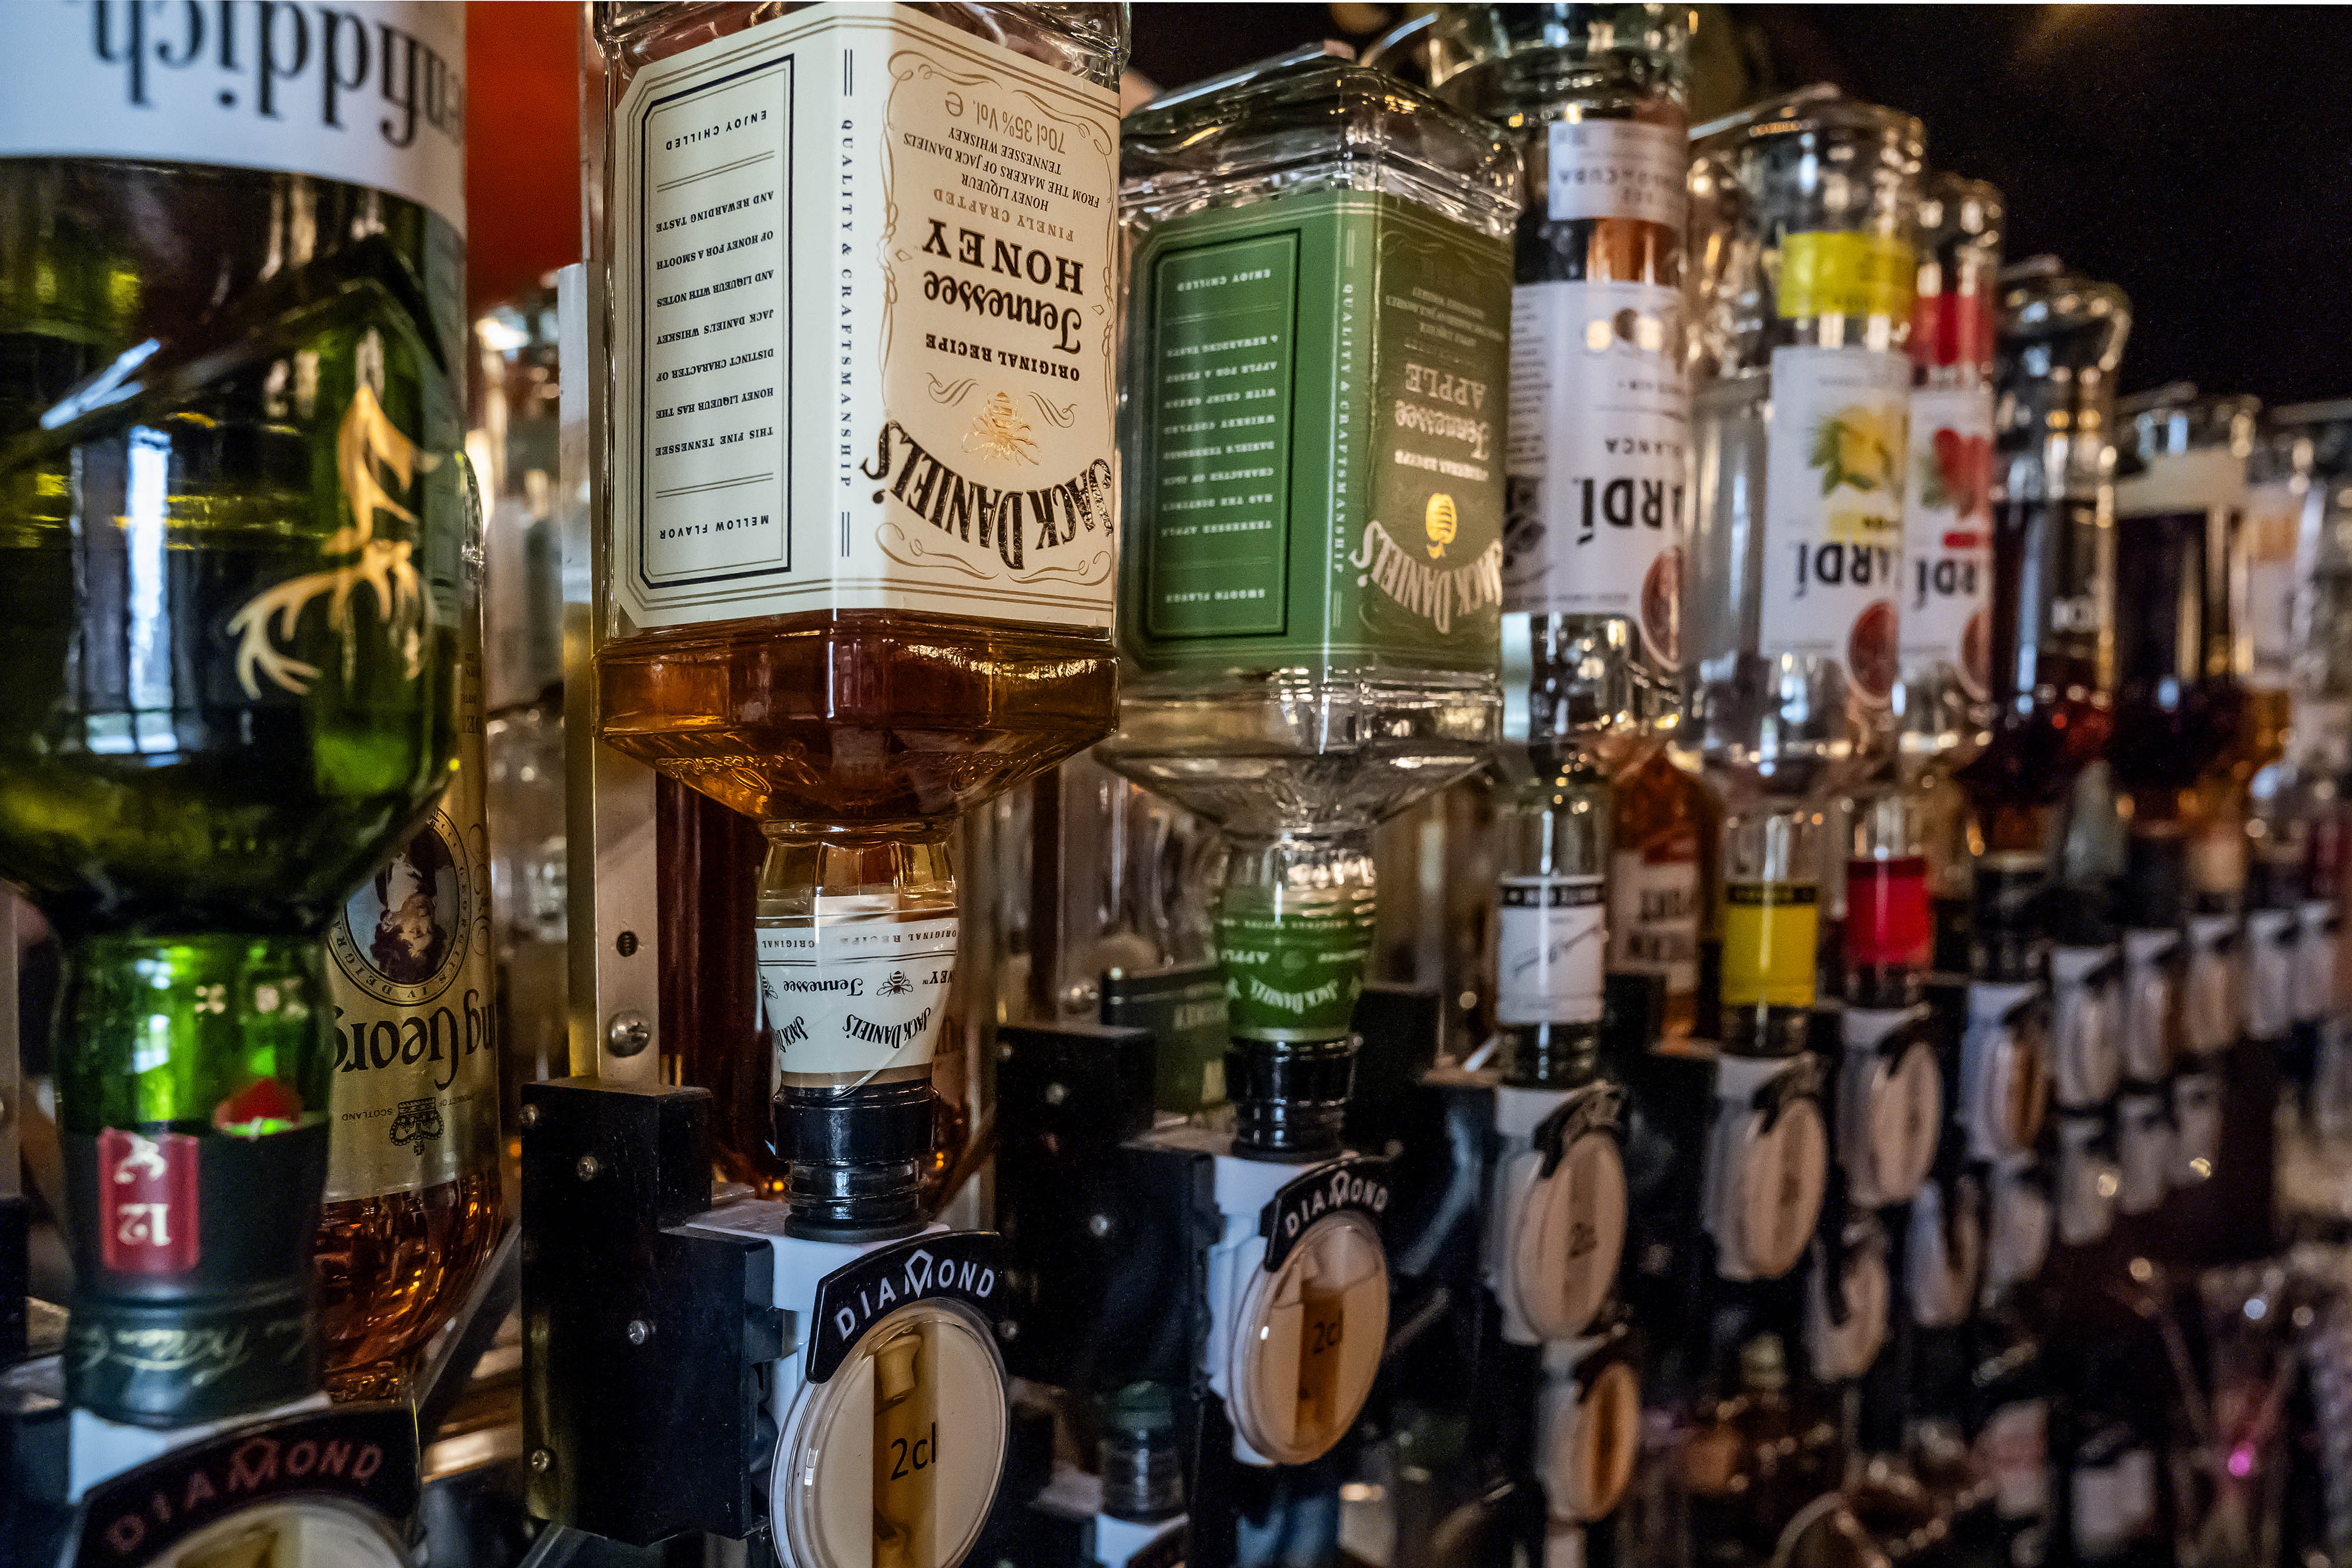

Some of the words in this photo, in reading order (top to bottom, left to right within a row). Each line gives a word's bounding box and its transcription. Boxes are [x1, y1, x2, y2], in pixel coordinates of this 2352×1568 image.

[725, 110, 767, 132] ENJOY
[973, 99, 998, 129] Vol.
[1002, 111, 1033, 142] 35%
[664, 126, 720, 151] CHILLED
[903, 133, 952, 160] DANIEL'S
[948, 126, 998, 153] WHISKEY
[1037, 123, 1065, 155] 70cl
[955, 149, 982, 169] JACK
[983, 161, 997, 173] OF
[1001, 145, 1061, 175] TENNESSEE
[841, 120, 853, 231] QUALITY
[1000, 165, 1045, 189] MAKERS
[961, 173, 1010, 200] LIQUEUR
[1048, 181, 1069, 198] THE
[753, 191, 774, 205] AND
[933, 188, 1010, 223] CRAFTED
[1011, 188, 1050, 212] HONEY
[1071, 188, 1100, 208] FROM
[690, 198, 750, 222] REWARDING
[656, 216, 687, 233] TASTE
[1017, 214, 1074, 242] FINELY
[727, 235, 759, 250] HONEY
[761, 231, 773, 241] OF
[697, 250, 704, 259] A
[706, 244, 724, 256] FOR
[842, 243, 851, 256] &
[921, 218, 1084, 296] HONEY
[656, 252, 696, 269] SMOOTH
[713, 276, 751, 294] LIQUEUR
[755, 270, 774, 283] AND
[656, 292, 687, 307] NOTES
[689, 287, 710, 300] WITH
[749, 309, 774, 323] JACK
[923, 270, 1083, 355] Tennessee
[703, 316, 746, 334] DANIEL'S
[1340, 284, 1354, 373] QUALITY
[656, 328, 700, 345] WHISKEY
[730, 349, 774, 366] DISTINCT
[925, 334, 992, 362] RECIPE
[671, 360, 727, 379] CHARACTER
[997, 350, 1080, 382] ORIGINAL
[656, 372, 669, 382] OF
[841, 269, 851, 487] CRAFTSMANSHIP
[1405, 362, 1486, 412] APPLE
[698, 395, 739, 410] LIQUEUR
[741, 388, 773, 402] HONEY
[656, 408, 674, 419] THE
[677, 403, 695, 415] HAS
[720, 432, 744, 444] FINE
[749, 426, 773, 439] THIS
[655, 438, 714, 456] TENNESSEE
[859, 420, 1025, 570] DANIEL'S
[1334, 400, 1349, 573] CRAFTSMANSHIP
[1027, 459, 1113, 550] JACK
[659, 524, 708, 539] FLAVOR
[715, 515, 769, 531] MELLOW
[1348, 520, 1451, 634] DANIEL'S
[908, 930, 956, 941] ORIGINAL
[356, 968, 392, 995] DEI
[783, 978, 863, 996] Tennessee
[407, 988, 427, 998] IV
[782, 1016, 808, 1046] JACK
[842, 1014, 900, 1049] DANIEL'S
[903, 1007, 931, 1044] JACK
[342, 1108, 393, 1121] SCOTLAND
[1285, 1169, 1389, 1238] DIAMOND
[116, 1203, 171, 1246] 12
[833, 1249, 995, 1341] DIAMOND
[890, 1422, 937, 1481] 2cl
